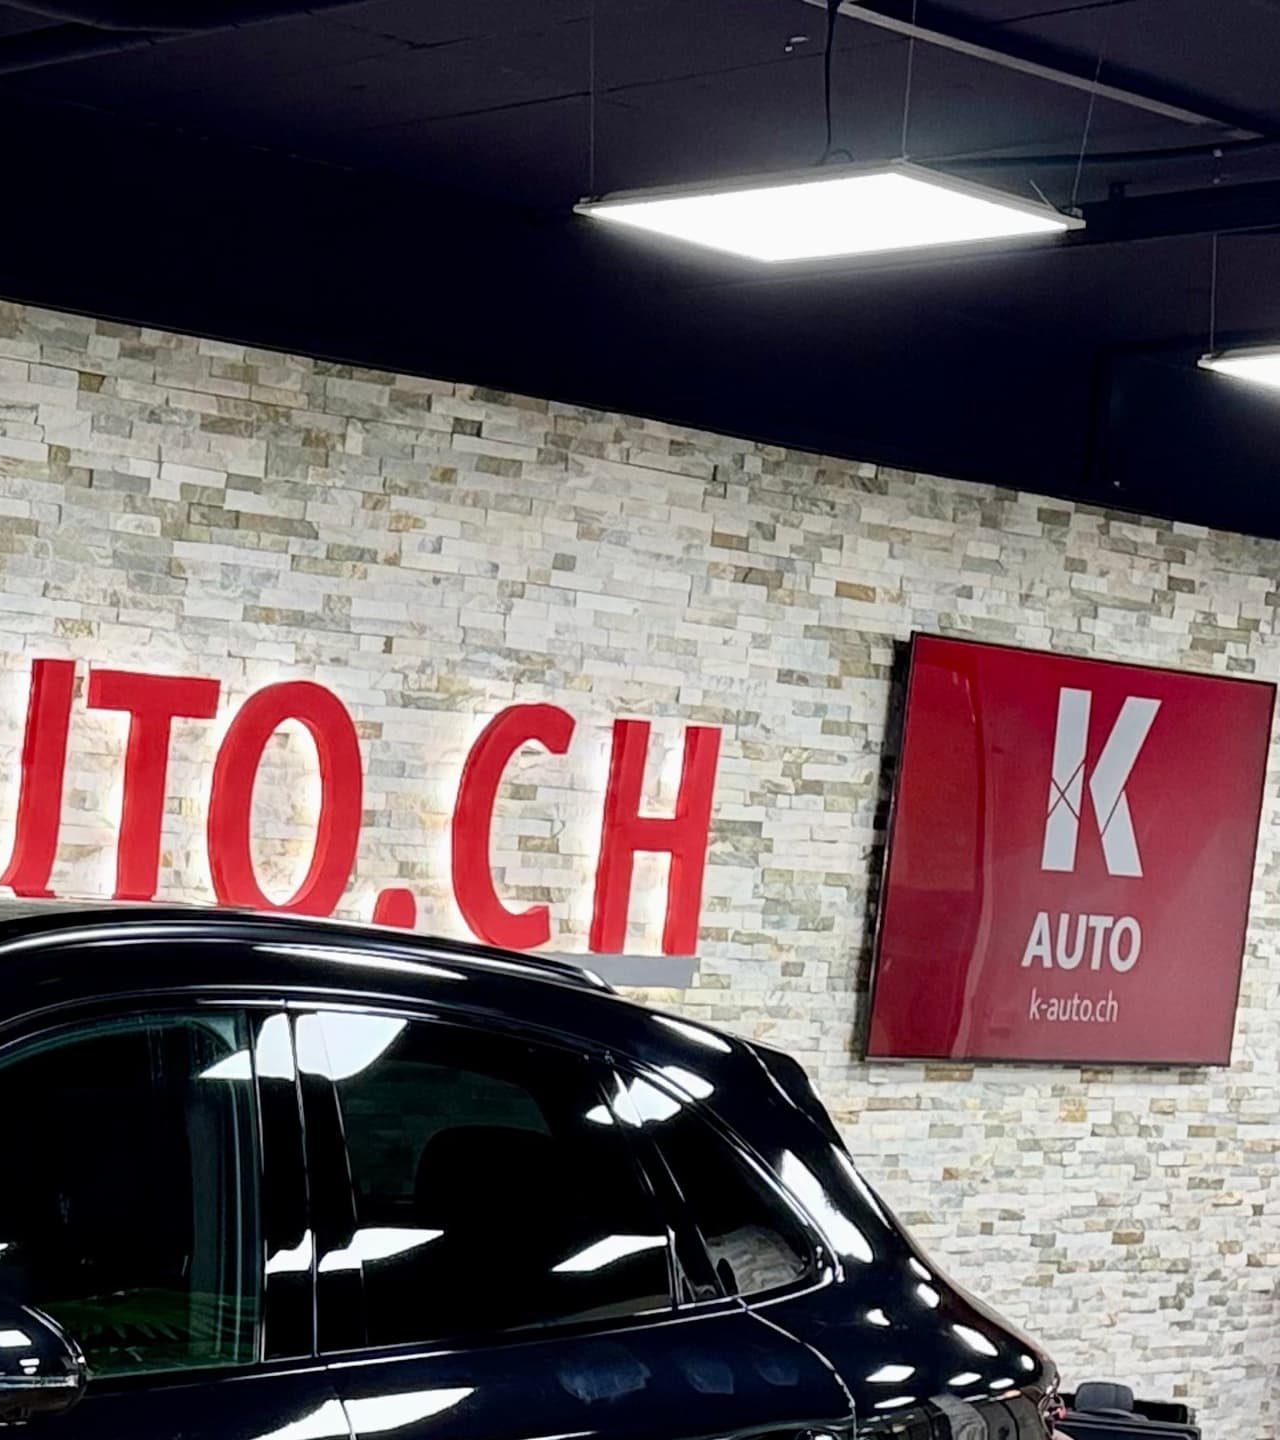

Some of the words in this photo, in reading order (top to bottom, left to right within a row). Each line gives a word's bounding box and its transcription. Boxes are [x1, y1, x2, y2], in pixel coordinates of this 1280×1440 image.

[1041, 687, 1162, 878] K
[1021, 911, 1142, 973] AUTO
[1029, 987, 1119, 1023] k-auto.ch
